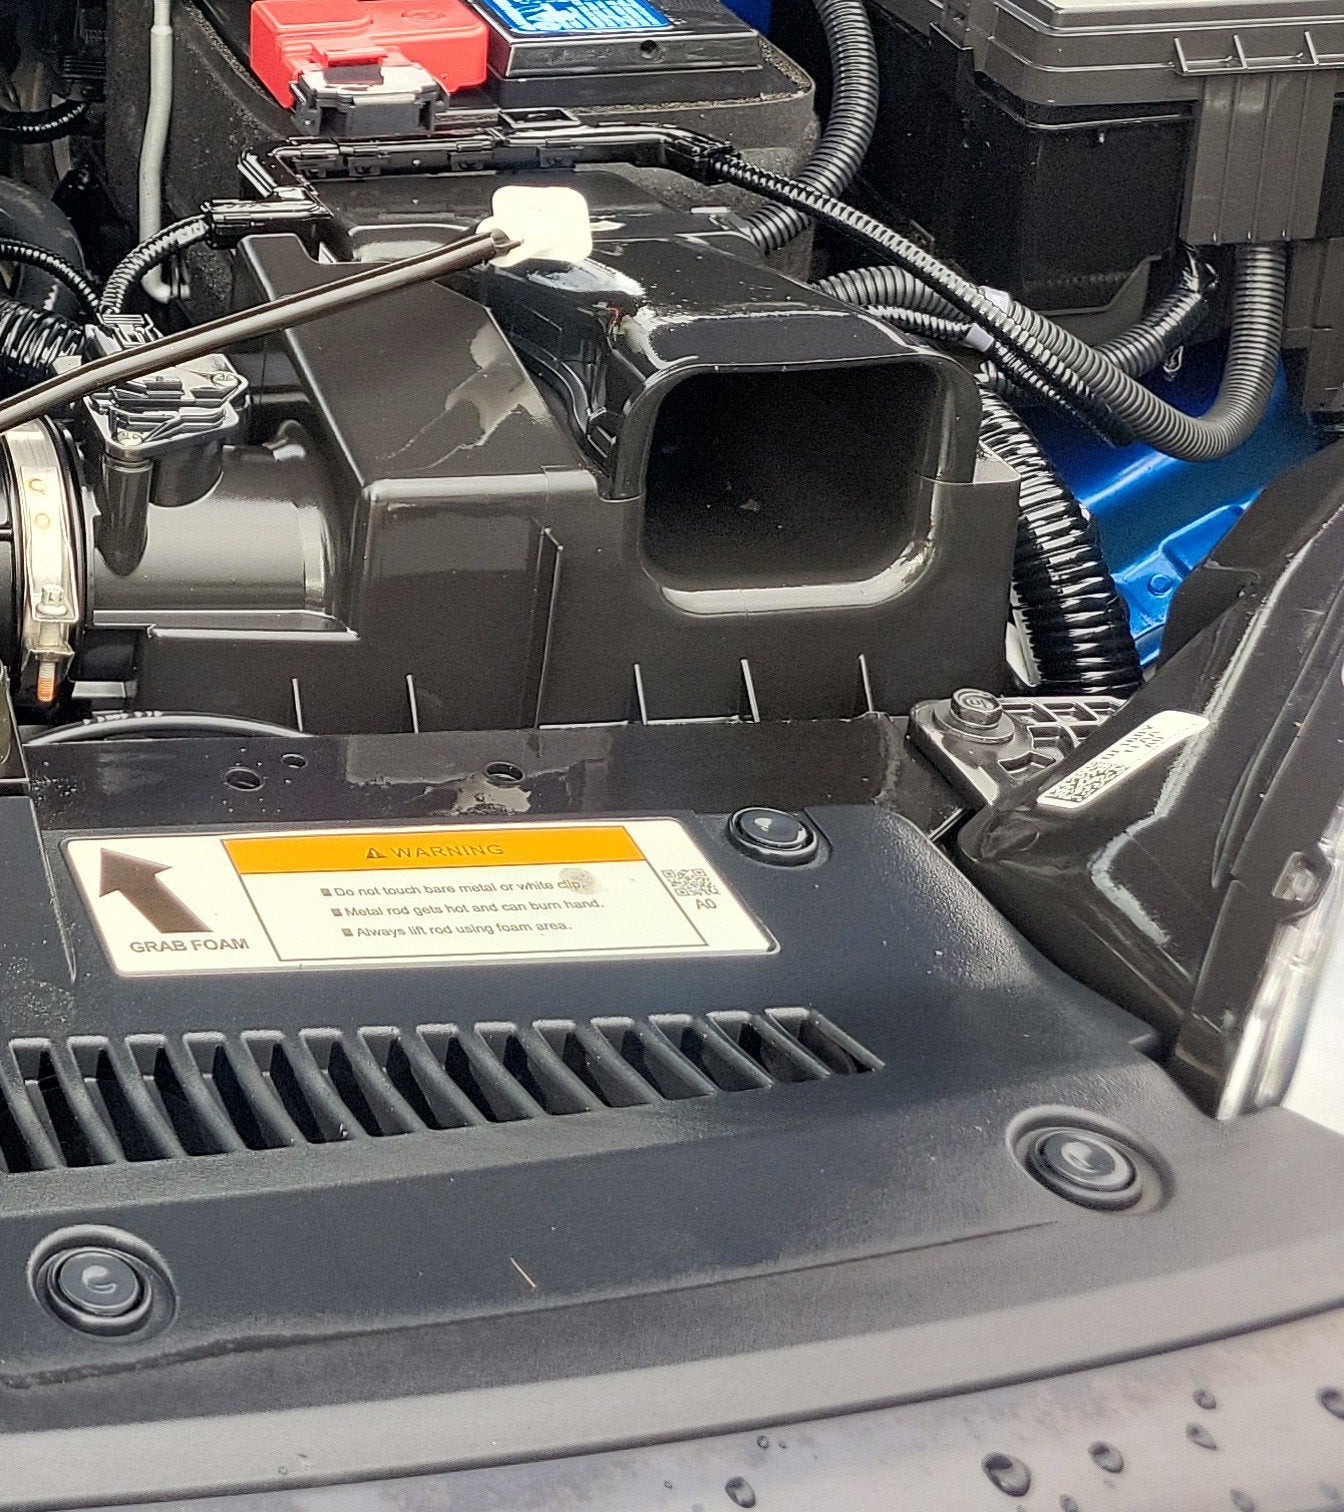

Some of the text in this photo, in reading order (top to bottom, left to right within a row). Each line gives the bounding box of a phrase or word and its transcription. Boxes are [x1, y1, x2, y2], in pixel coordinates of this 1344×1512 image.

[390, 844, 505, 859] WARNING
[334, 887, 355, 897] Do
[358, 886, 381, 896] not
[382, 883, 422, 896] touch
[423, 884, 456, 894] bare
[458, 882, 497, 894] metal
[499, 883, 514, 892] or
[516, 880, 555, 891] white
[344, 898, 605, 918] Metal rod gets hot and can burn hand.
[356, 921, 573, 939] Always lift rod using foam area.
[129, 937, 250, 953] GRAB FOAM
